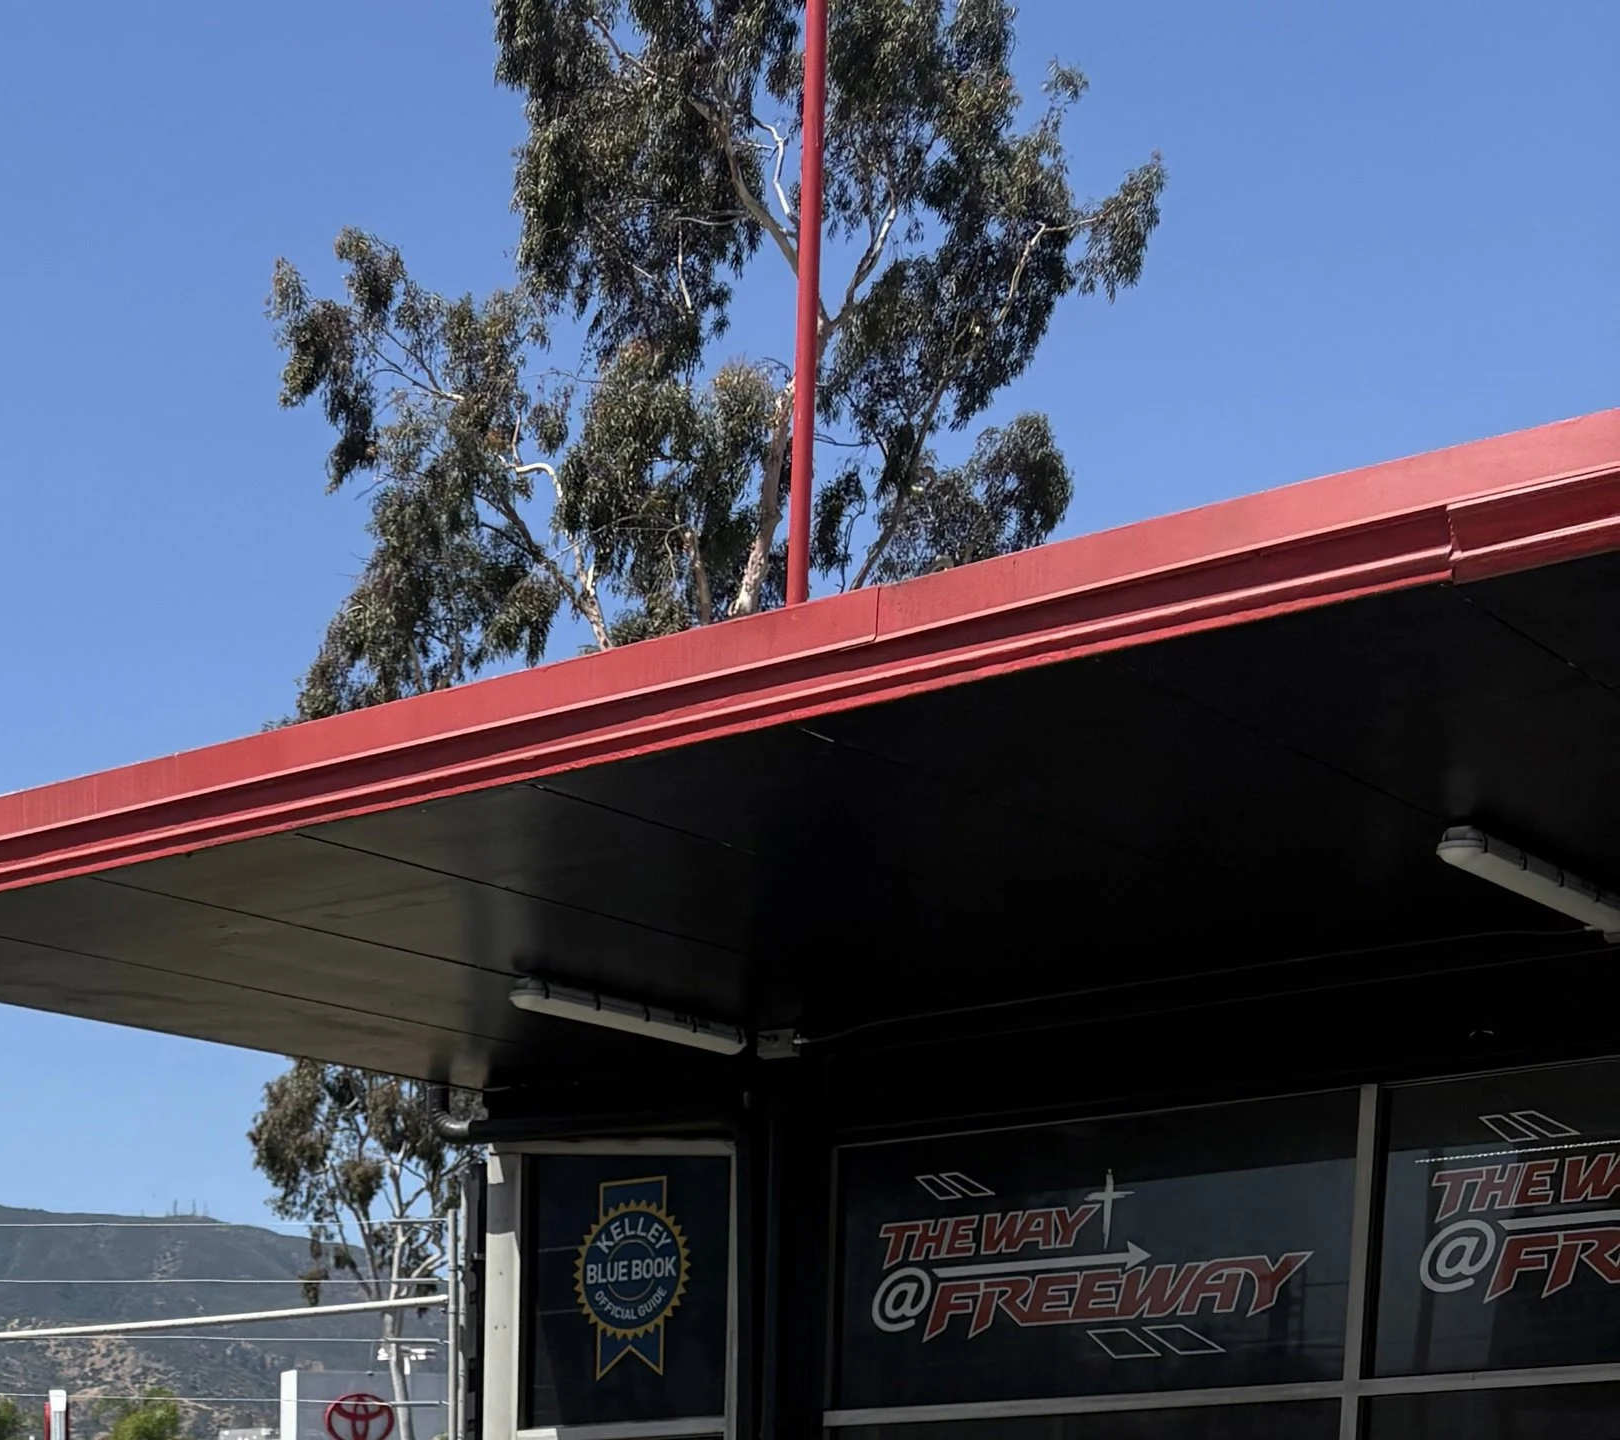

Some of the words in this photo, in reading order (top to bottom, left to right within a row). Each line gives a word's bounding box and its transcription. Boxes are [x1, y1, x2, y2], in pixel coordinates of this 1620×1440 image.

[596, 1216, 672, 1254] KELLEY
[586, 1260, 628, 1285] BLUE
[631, 1255, 677, 1281] BOOK
[594, 1290, 638, 1320] OFFICIAL
[637, 1286, 668, 1317] GUIDE
